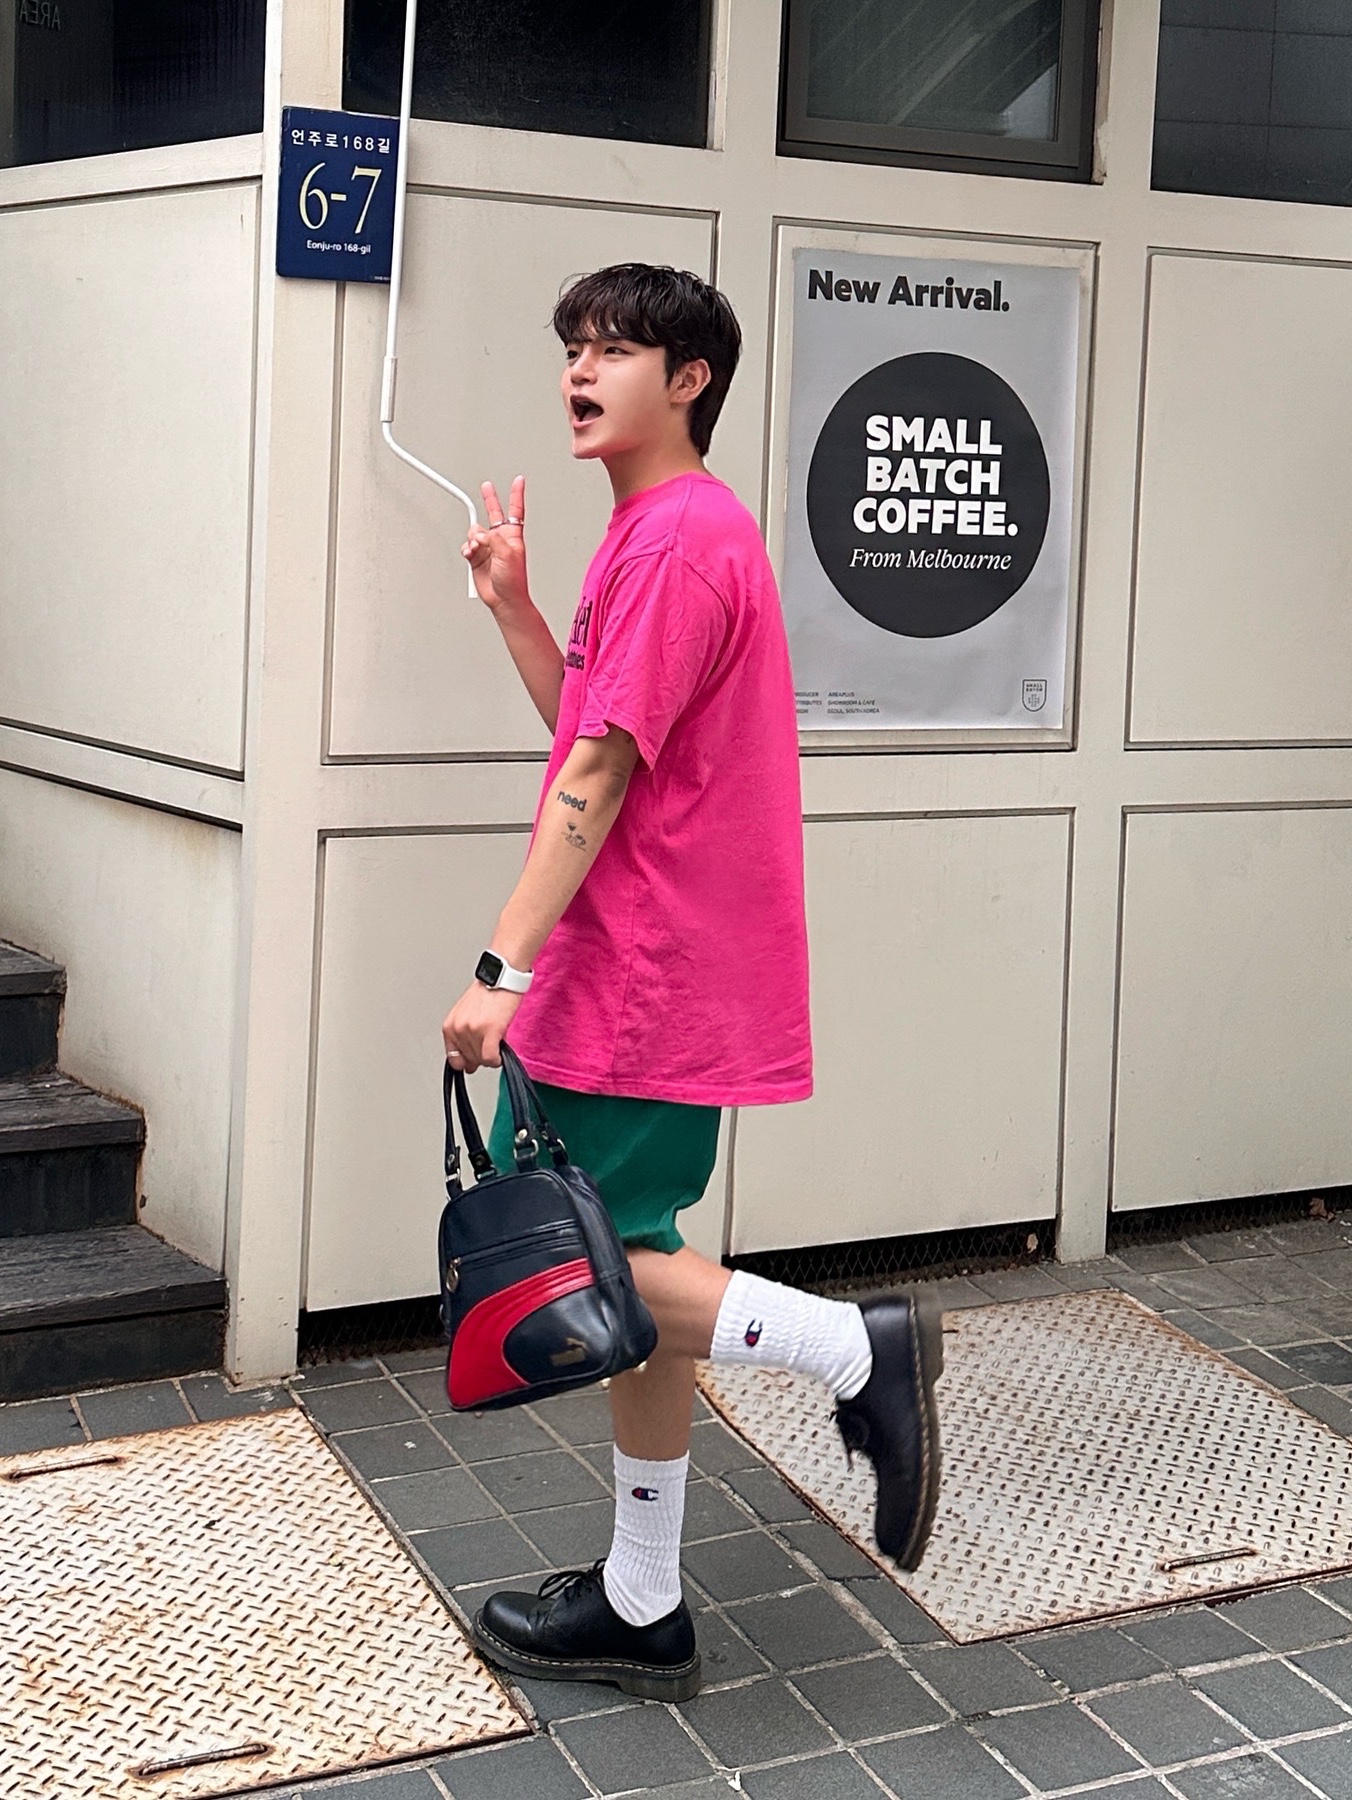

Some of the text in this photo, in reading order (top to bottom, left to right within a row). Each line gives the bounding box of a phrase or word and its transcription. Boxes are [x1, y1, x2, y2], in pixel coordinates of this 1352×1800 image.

[291, 129, 391, 154] 언주로168길
[299, 162, 383, 235] 6-7
[306, 239, 372, 256] Eonju-ro 168-gil
[808, 269, 1010, 312] New Arrival.
[865, 414, 1002, 455] SMALL
[866, 456, 1000, 495] BATCH
[853, 497, 1018, 537] COFFEE.
[850, 548, 1012, 570] From Melbourne
[557, 791, 587, 812] need
